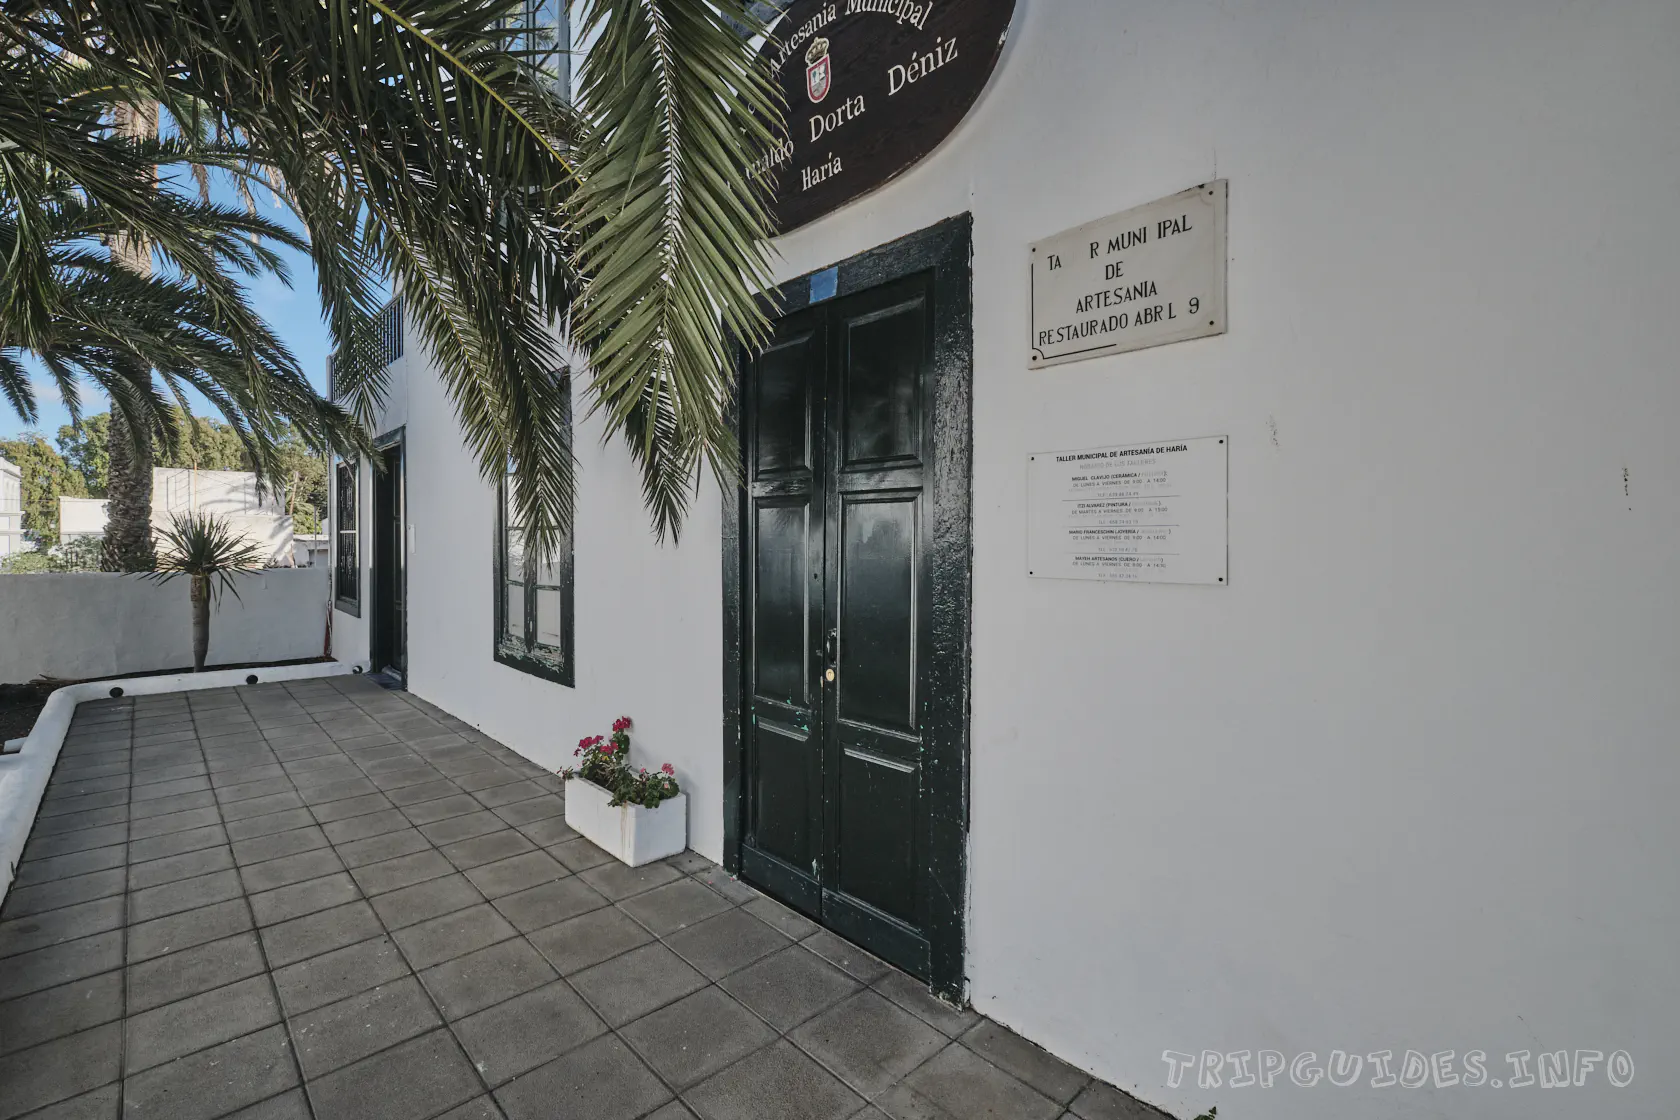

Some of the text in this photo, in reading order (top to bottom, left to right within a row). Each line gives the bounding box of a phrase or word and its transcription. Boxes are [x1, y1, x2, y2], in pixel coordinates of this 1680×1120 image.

[809, 94, 866, 143] Dorta
[887, 37, 958, 96] Déniz
[1105, 261, 1124, 280] DE
[1076, 281, 1158, 314] ARTESANIA
[1040, 313, 1128, 346] RESTAURADO
[1077, 453, 1108, 461] MUNICIPAL
[1120, 447, 1155, 457] ARTESANÍA
[1166, 444, 1187, 452] HARÍA
